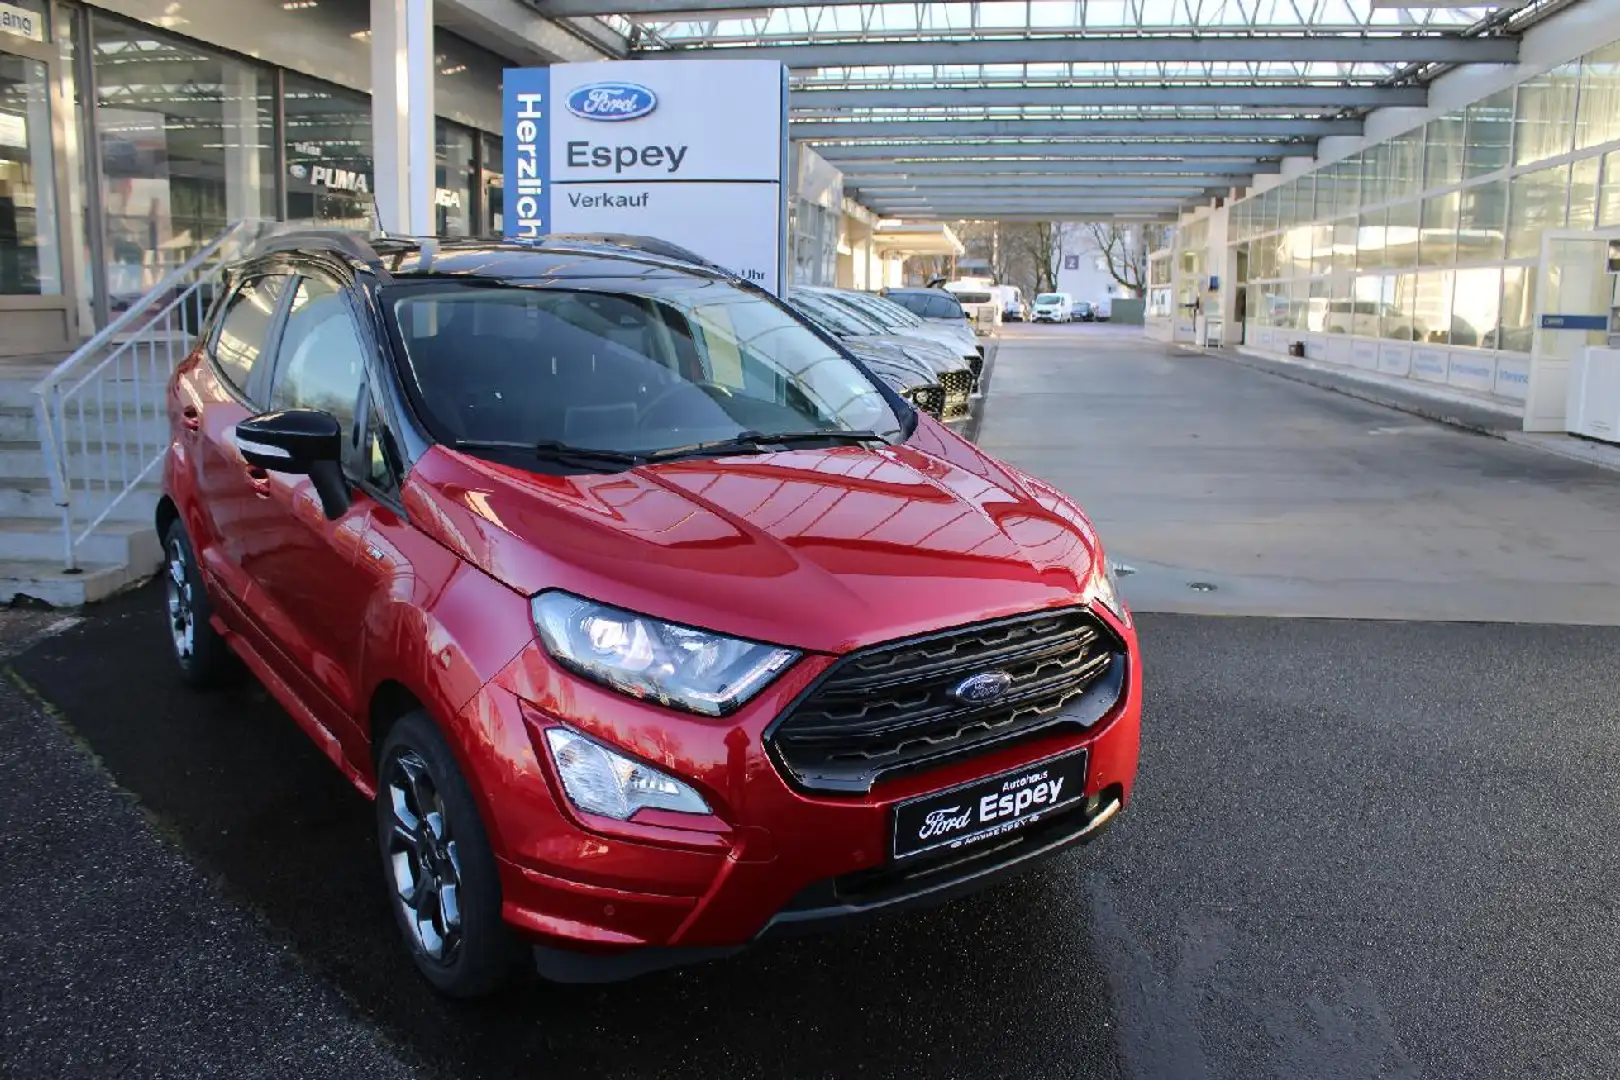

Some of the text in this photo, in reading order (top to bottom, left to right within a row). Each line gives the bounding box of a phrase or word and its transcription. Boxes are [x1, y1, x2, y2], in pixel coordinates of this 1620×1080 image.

[583, 88, 637, 113] Ford
[516, 93, 542, 237] Herzlich
[567, 141, 688, 173] Espey
[310, 165, 369, 193] PUMA
[568, 192, 649, 208] Verkauf
[741, 268, 766, 280] Uhr
[1002, 770, 1048, 793] Autohaus
[919, 805, 972, 839] Ford
[980, 776, 1064, 823] Espey
